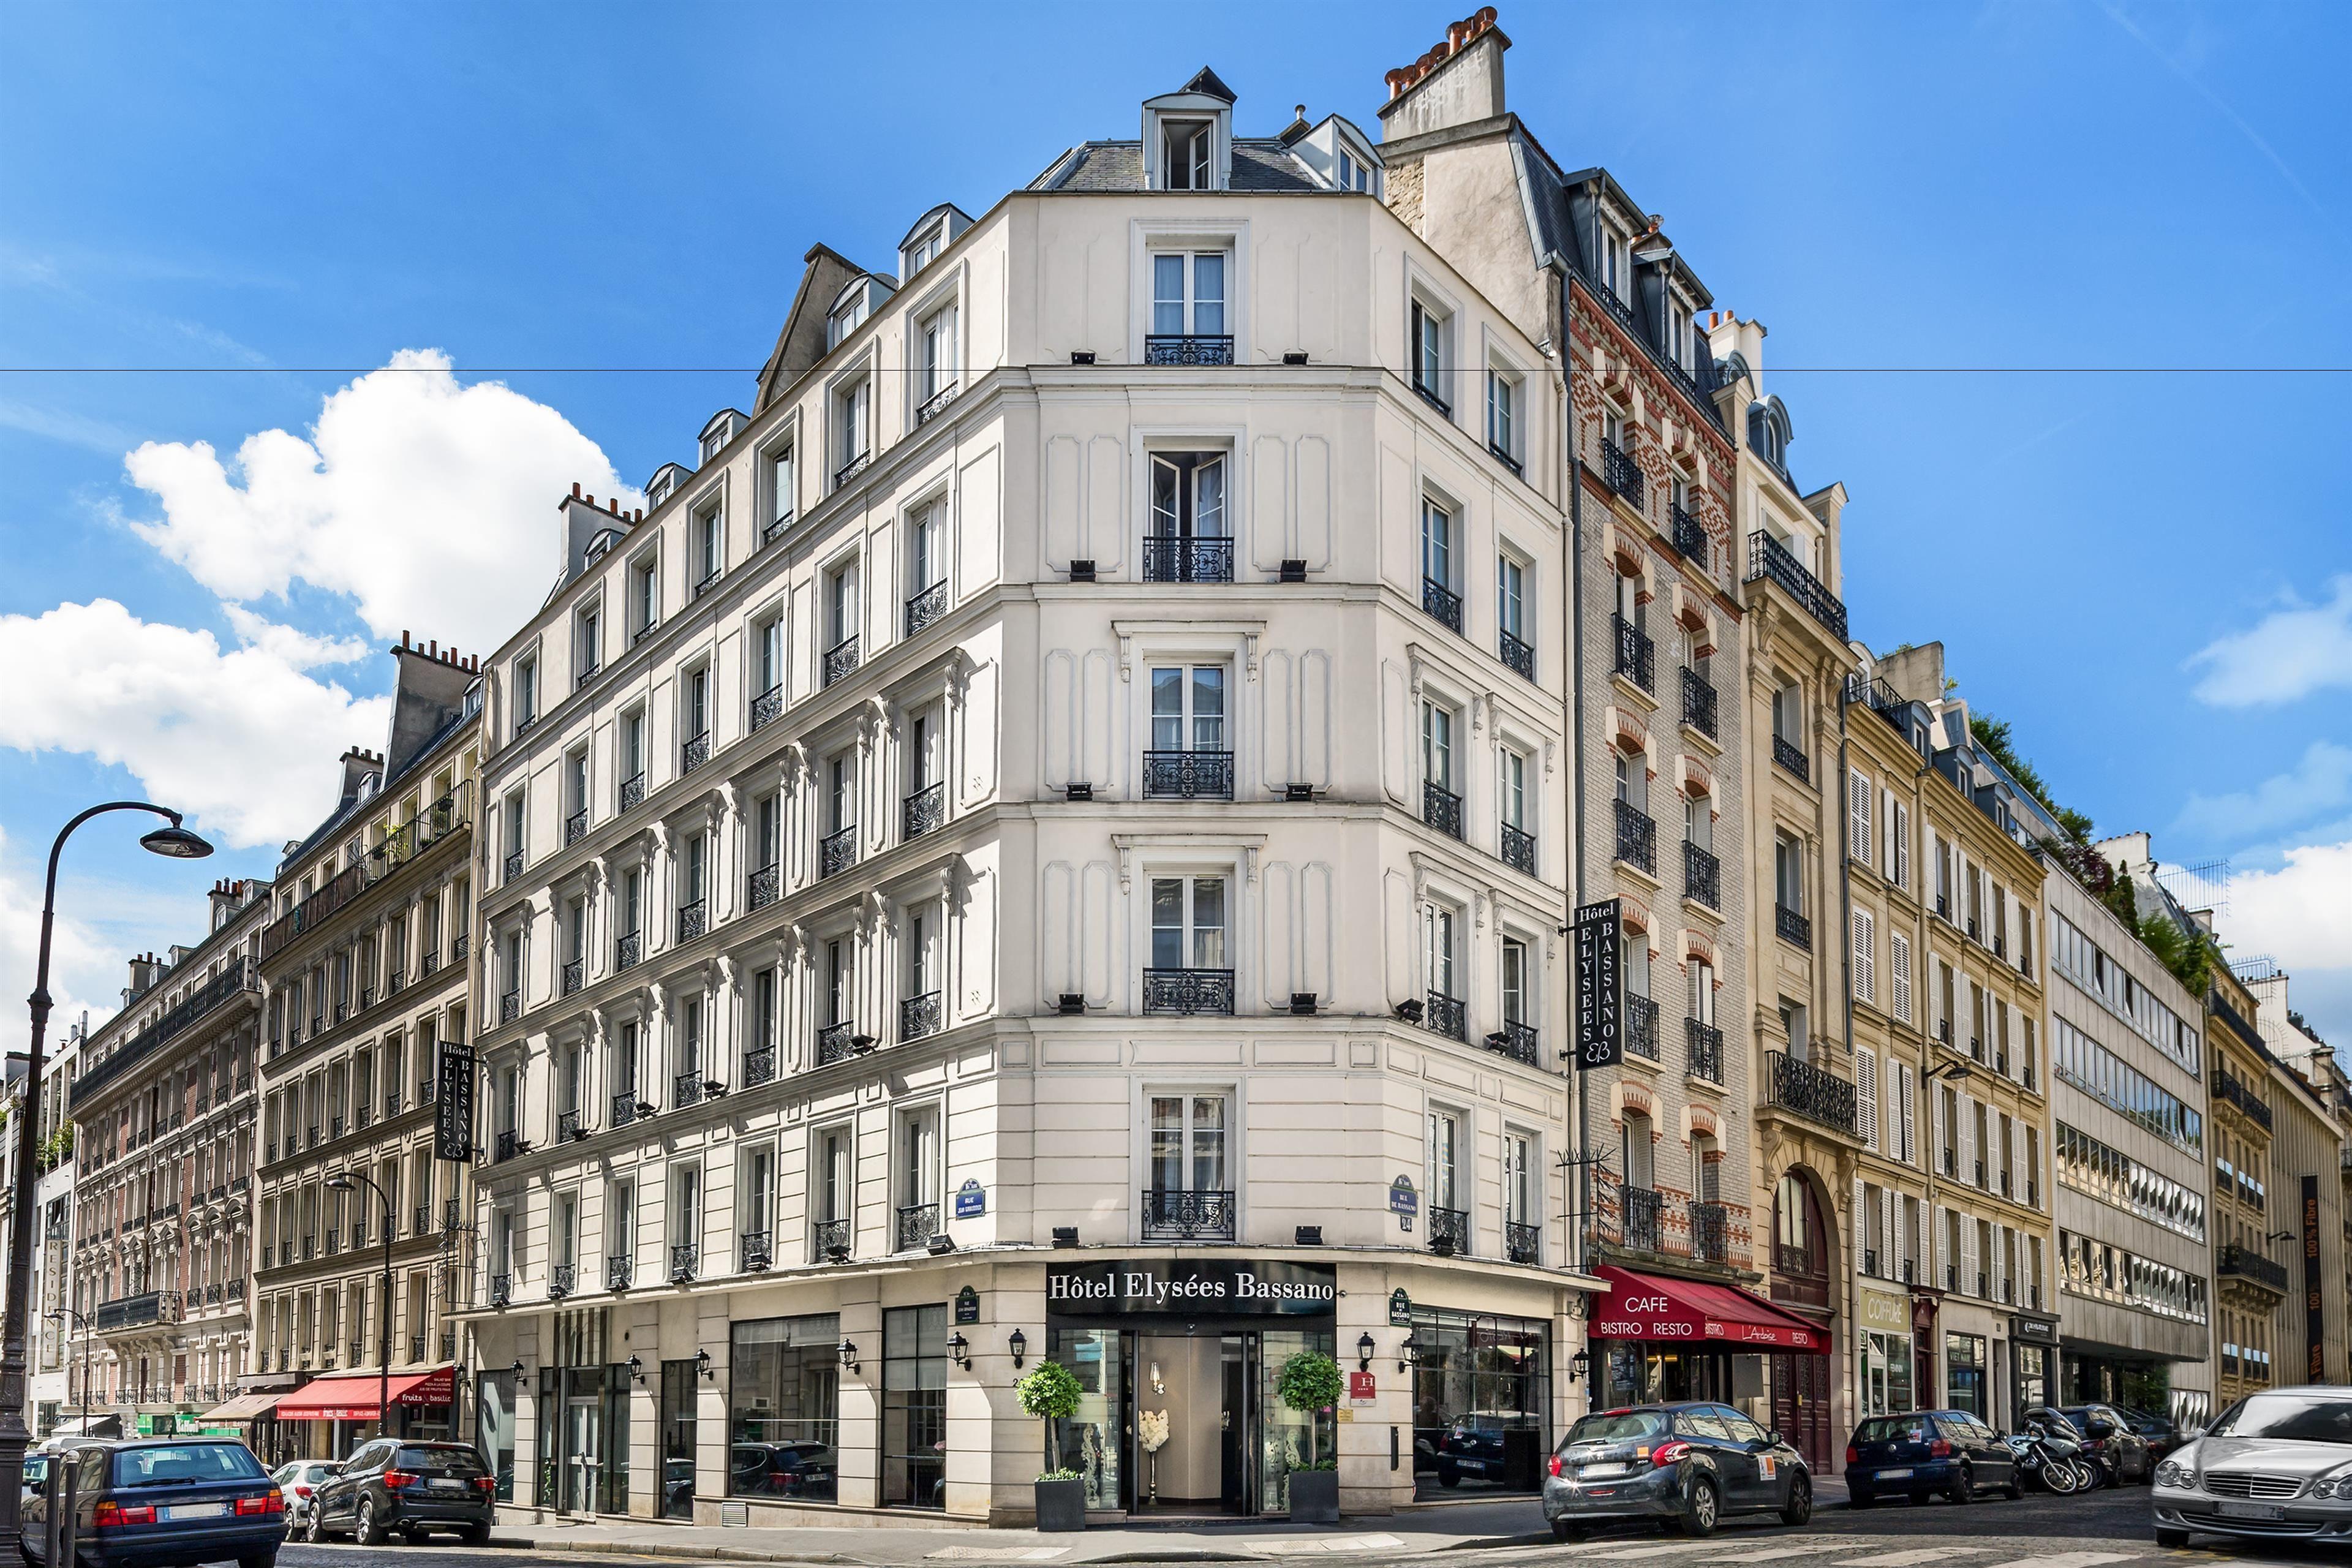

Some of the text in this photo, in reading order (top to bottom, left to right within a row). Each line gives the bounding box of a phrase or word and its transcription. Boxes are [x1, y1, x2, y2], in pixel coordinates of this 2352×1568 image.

[1579, 902, 1614, 923] Hôtel
[1581, 927, 1592, 1041] ELYSEES
[1602, 922, 1614, 1038] BASSANO
[443, 1044, 471, 1057] Hôtel
[443, 1058, 453, 1140] ELYSEES
[459, 1060, 469, 1142] BASSANO
[1401, 1218, 1411, 1230] 24
[2305, 1199, 2316, 1226] Fibre
[1049, 1272, 1334, 1305] Hôtel Elysées Bassano
[1625, 1297, 1668, 1313] CAFE
[1869, 1297, 1902, 1324] COIFFURE
[1600, 1322, 1692, 1336] BISTRO RESTO
[1705, 1323, 1807, 1344] BISTRO L'Ardoise RESTO
[1362, 1377, 1374, 1387] H
